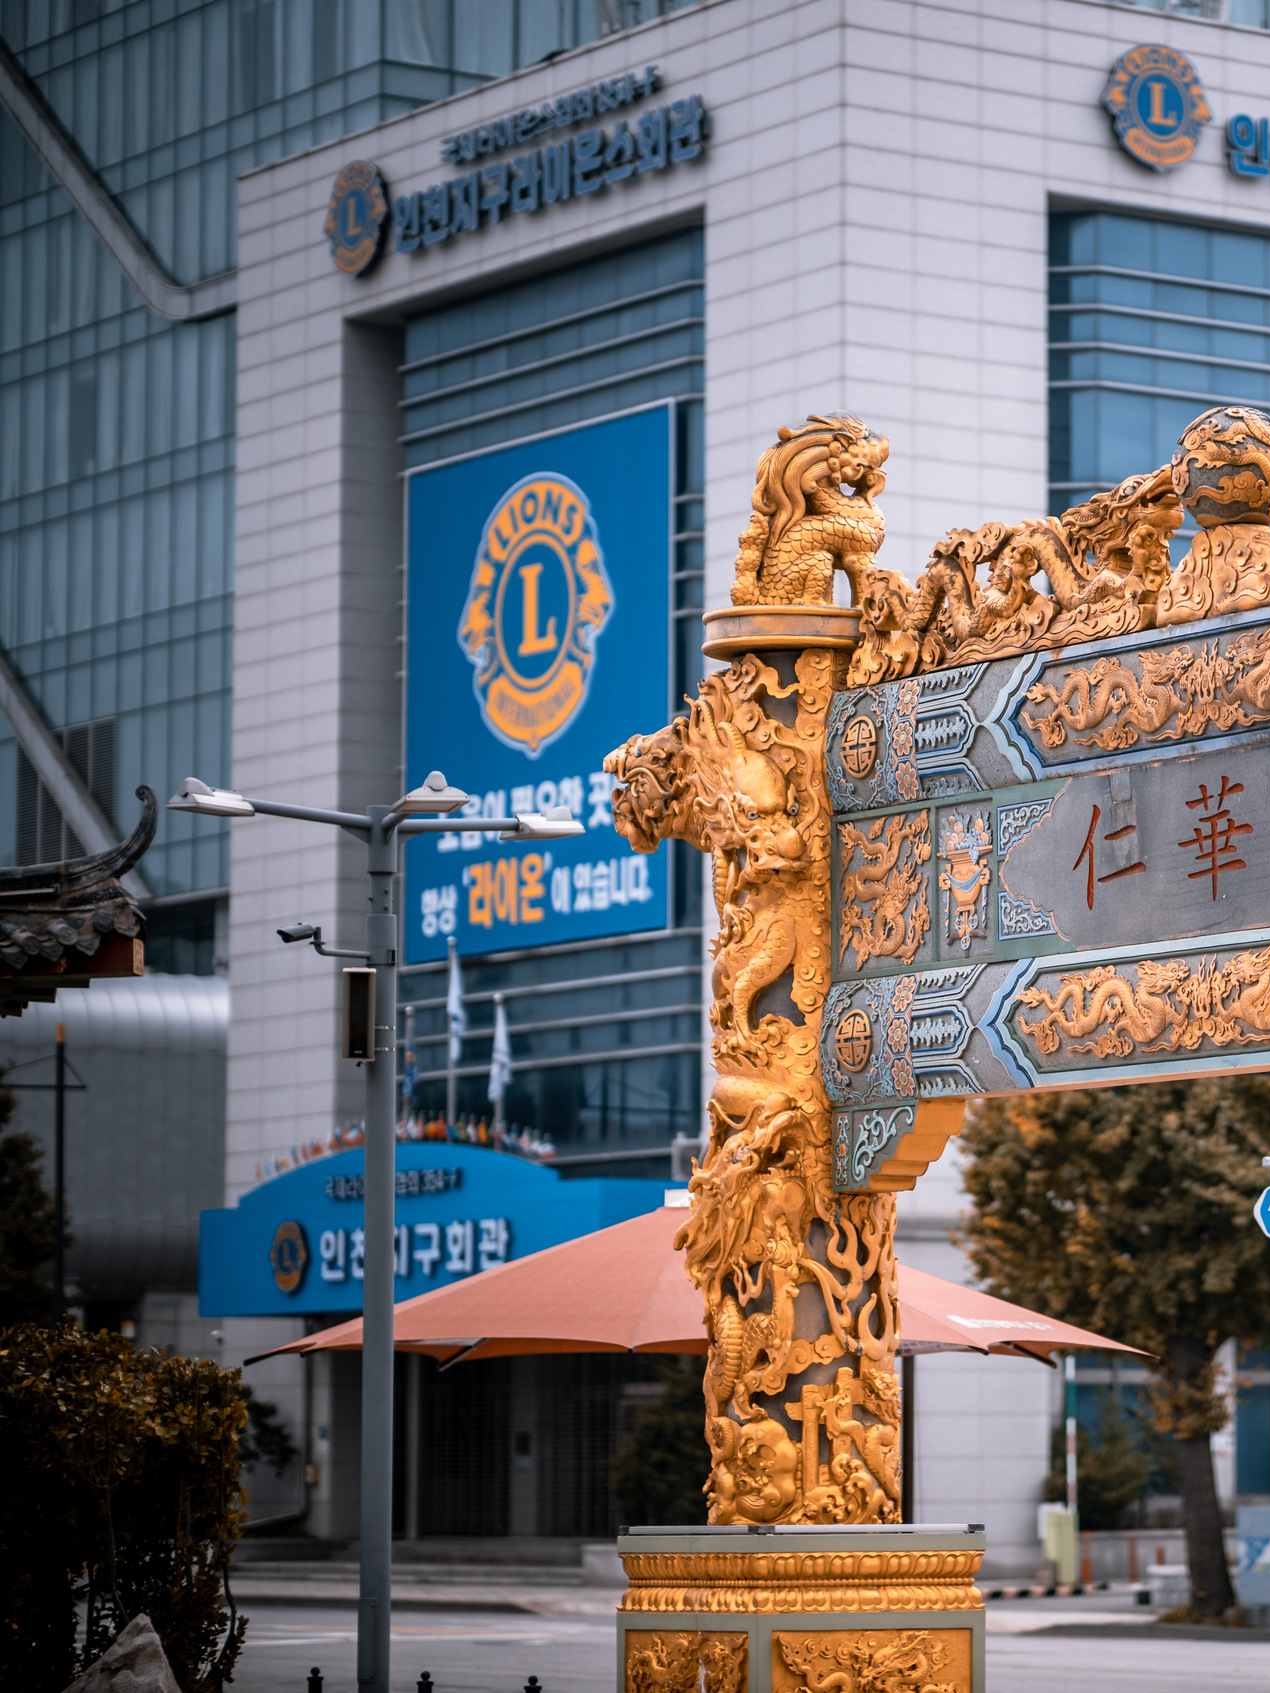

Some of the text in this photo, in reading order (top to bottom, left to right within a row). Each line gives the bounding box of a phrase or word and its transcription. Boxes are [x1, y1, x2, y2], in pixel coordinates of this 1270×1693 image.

[1147, 82, 1176, 127] L
[493, 487, 579, 551] LIONS
[518, 562, 558, 657] L
[420, 883, 458, 938] 항상
[572, 853, 653, 913] 있습니다.
